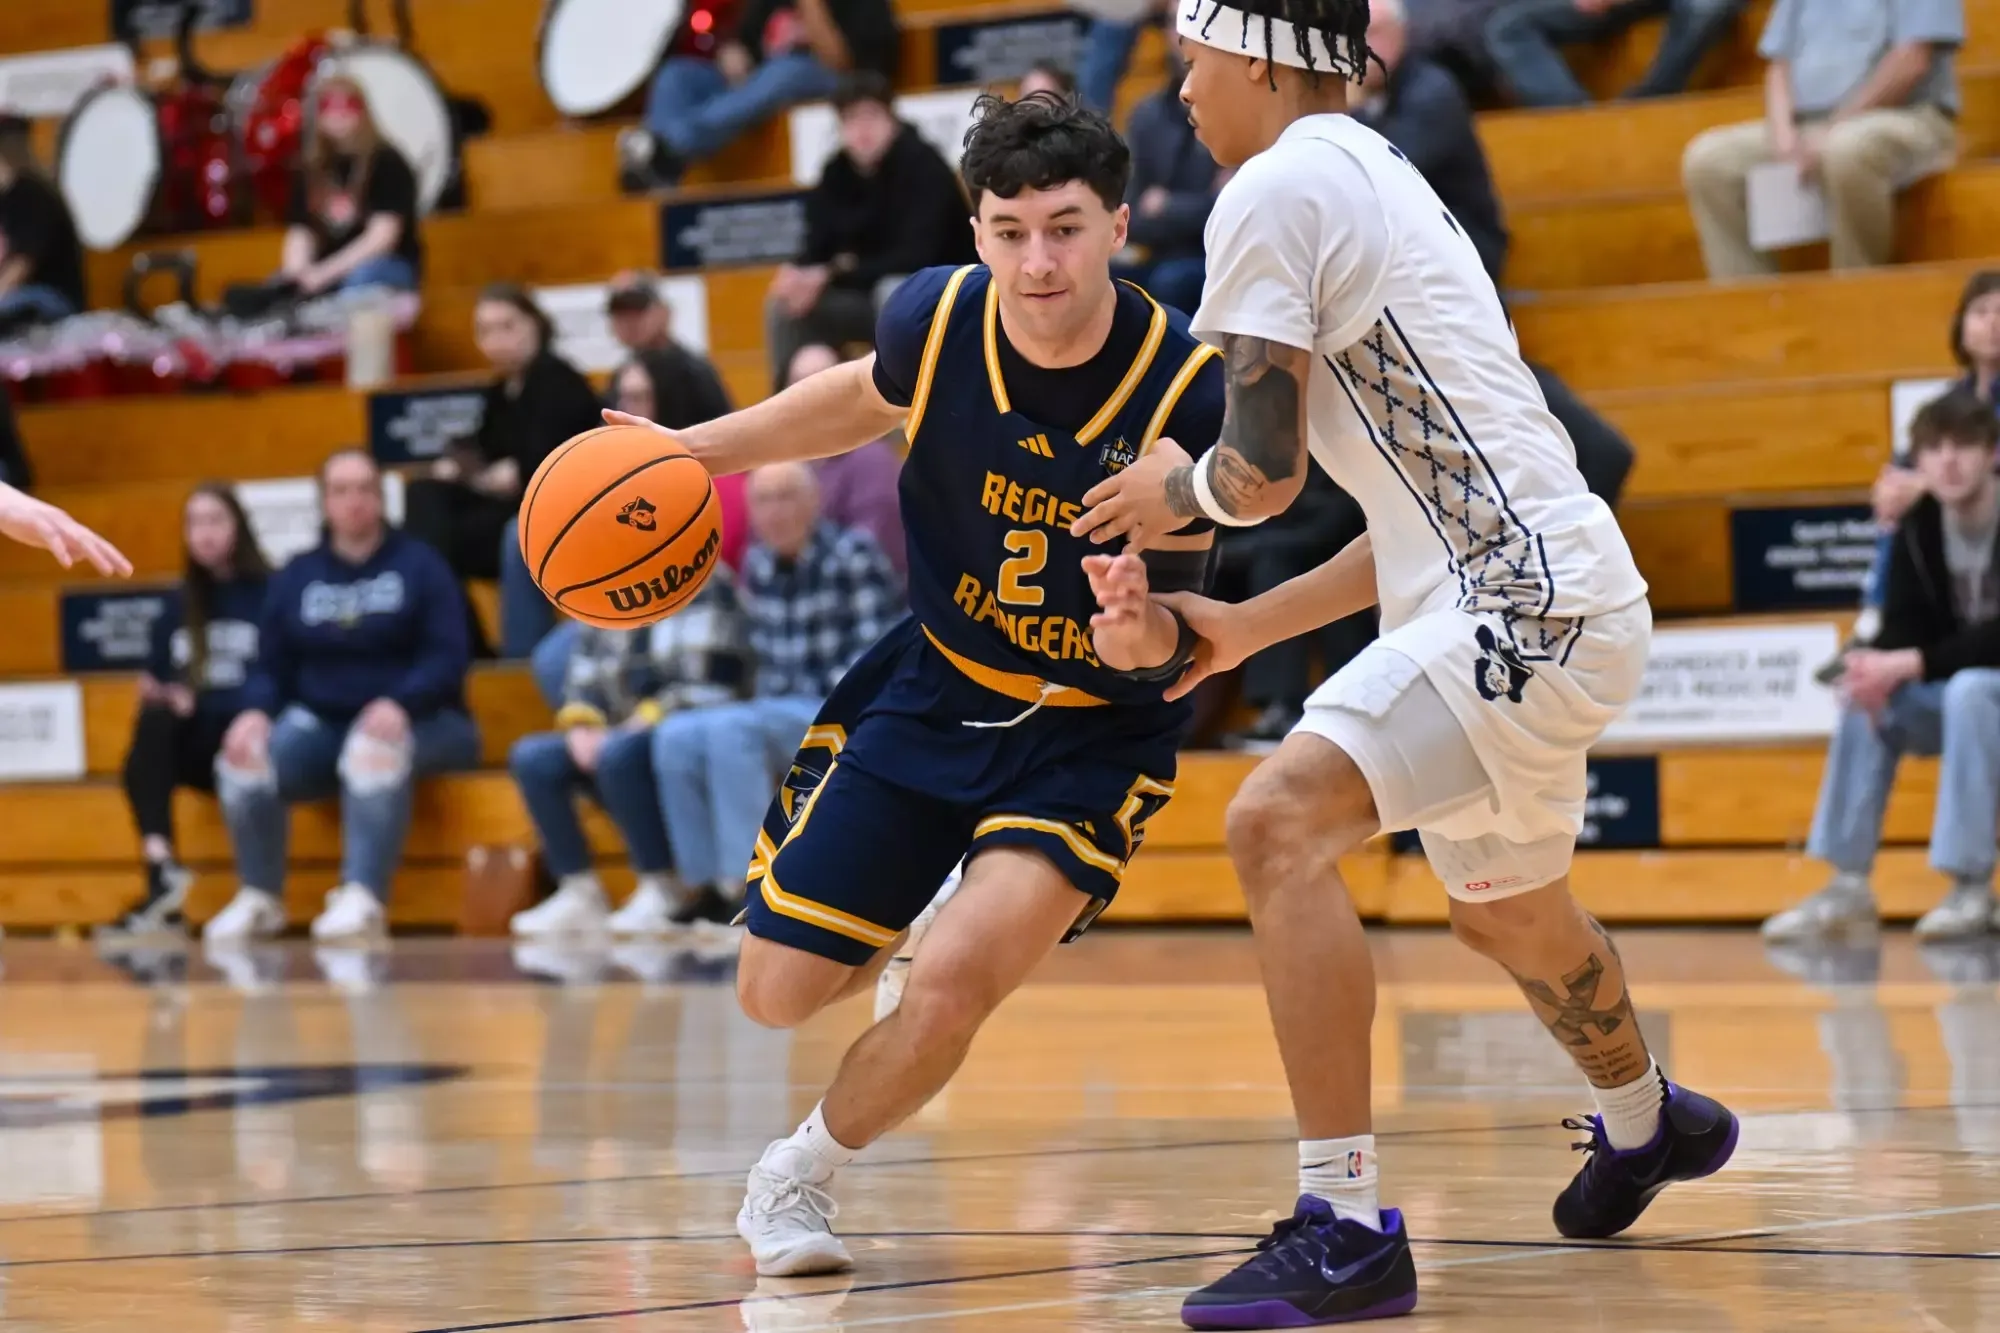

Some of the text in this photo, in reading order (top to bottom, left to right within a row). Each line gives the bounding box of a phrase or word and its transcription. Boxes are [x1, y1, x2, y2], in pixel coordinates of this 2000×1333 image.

[981, 470, 1082, 530] REGIS
[605, 528, 719, 611] Wilson
[998, 529, 1048, 606] 2
[954, 573, 1100, 667] RANGERS
